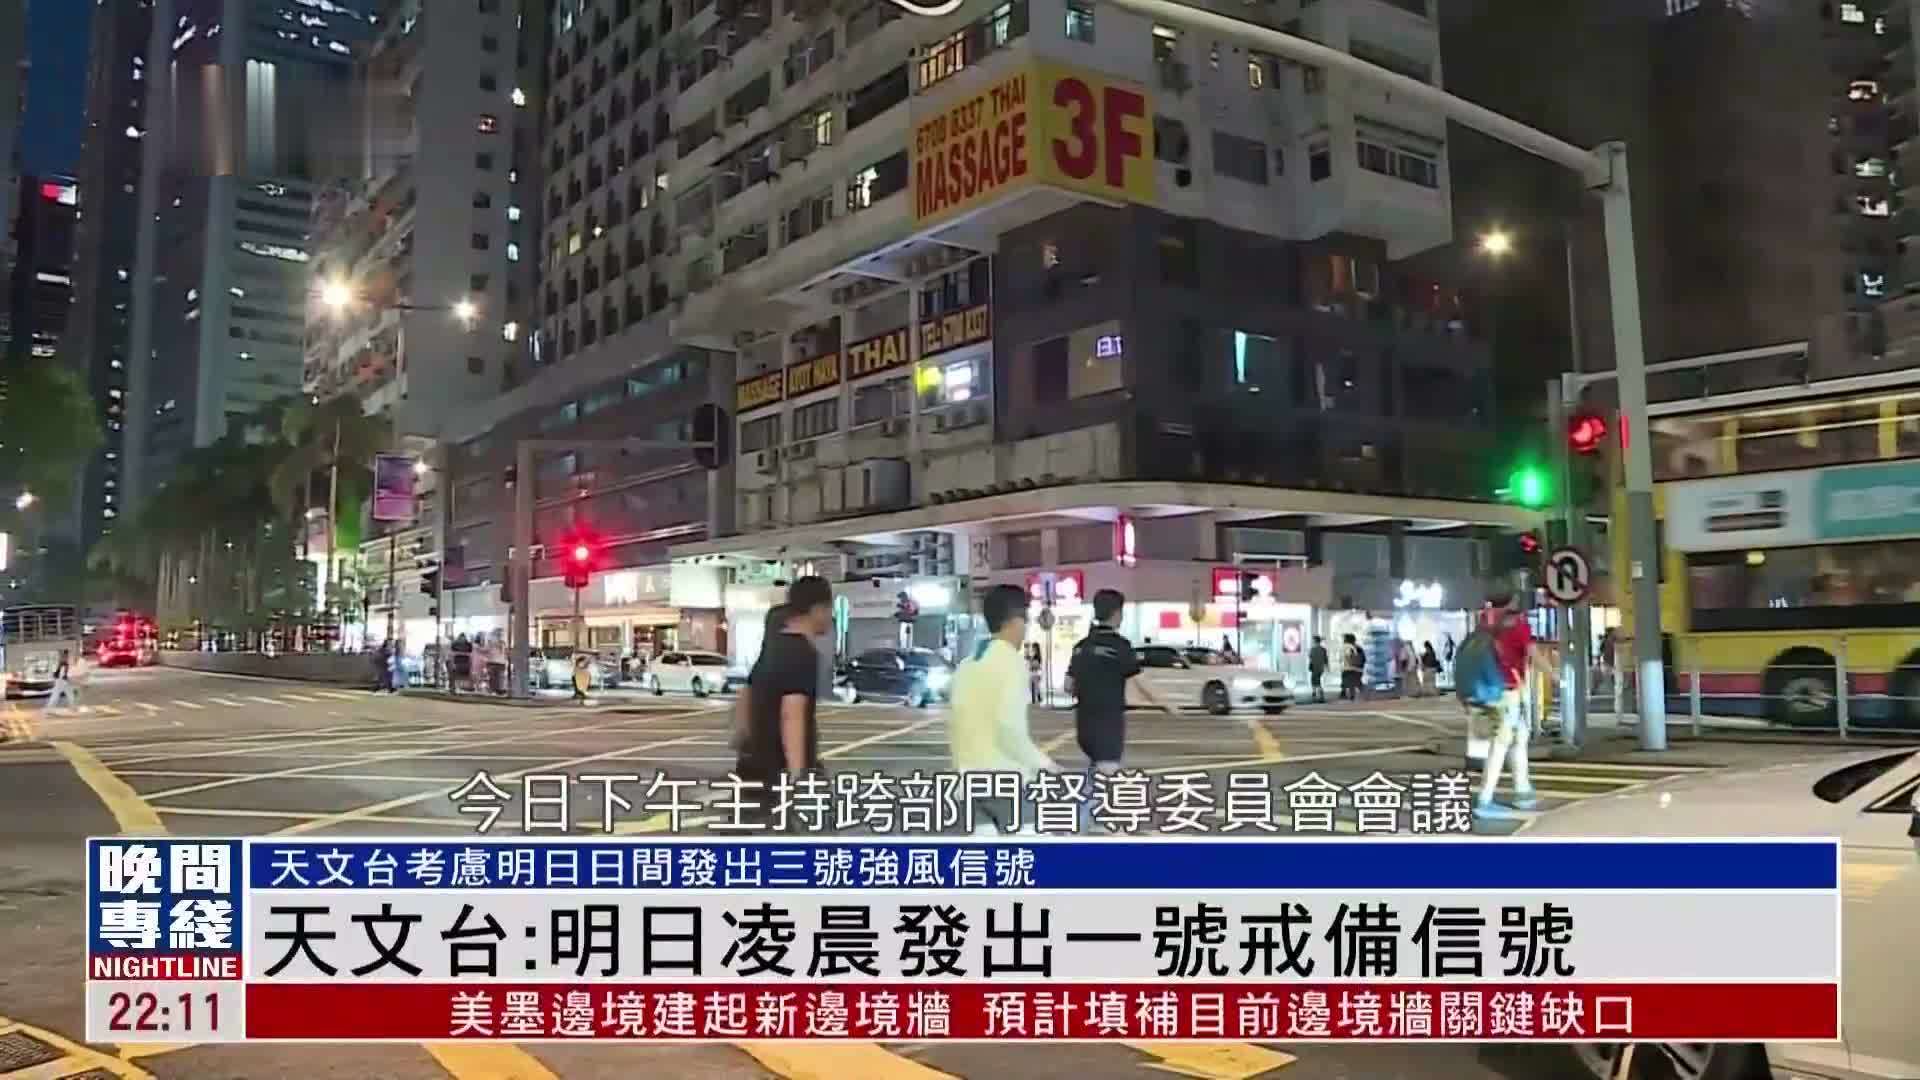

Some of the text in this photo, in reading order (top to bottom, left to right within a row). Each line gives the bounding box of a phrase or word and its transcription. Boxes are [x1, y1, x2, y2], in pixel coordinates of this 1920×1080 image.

[990, 75, 1026, 117] THAI
[1052, 78, 1146, 188] 3F
[915, 112, 1027, 221] MASSAGE
[852, 332, 907, 376] THAI
